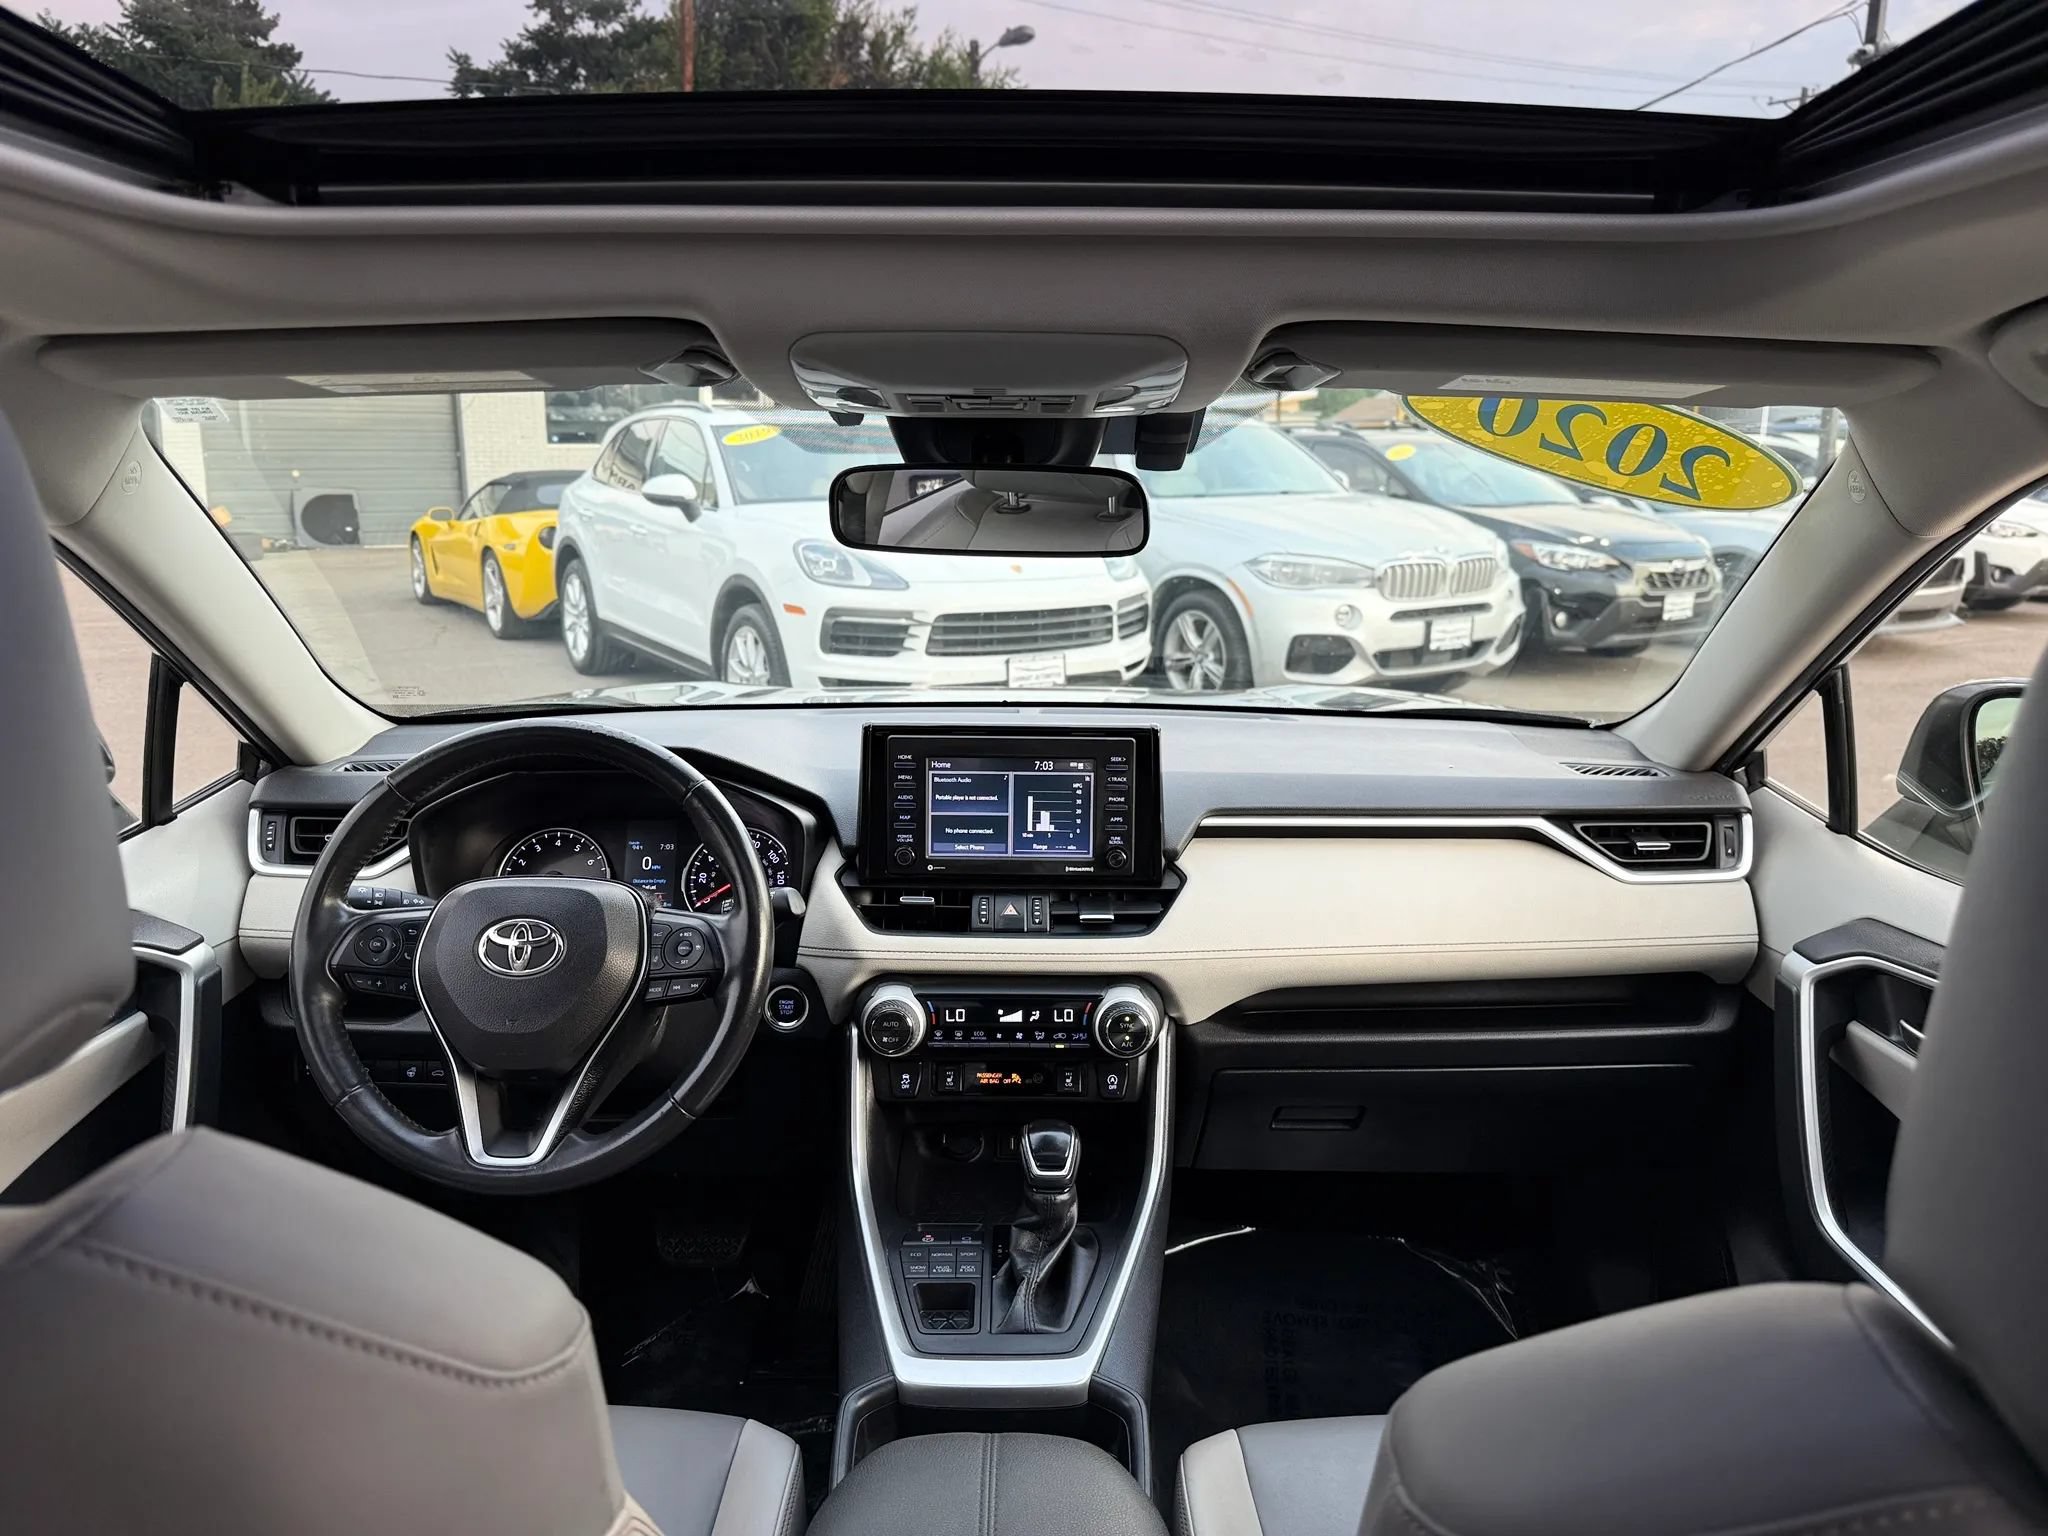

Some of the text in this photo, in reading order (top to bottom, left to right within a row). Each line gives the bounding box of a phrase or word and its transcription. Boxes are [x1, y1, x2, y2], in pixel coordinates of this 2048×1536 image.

[931, 760, 951, 769] Home
[1034, 761, 1054, 771] 7:03
[555, 839, 561, 847] 4
[574, 844, 581, 852] 5
[642, 856, 652, 870] 0
[767, 850, 780, 864] 100
[699, 872, 707, 884] 20
[945, 1009, 966, 1022] LO
[1054, 1009, 1074, 1022] LO
